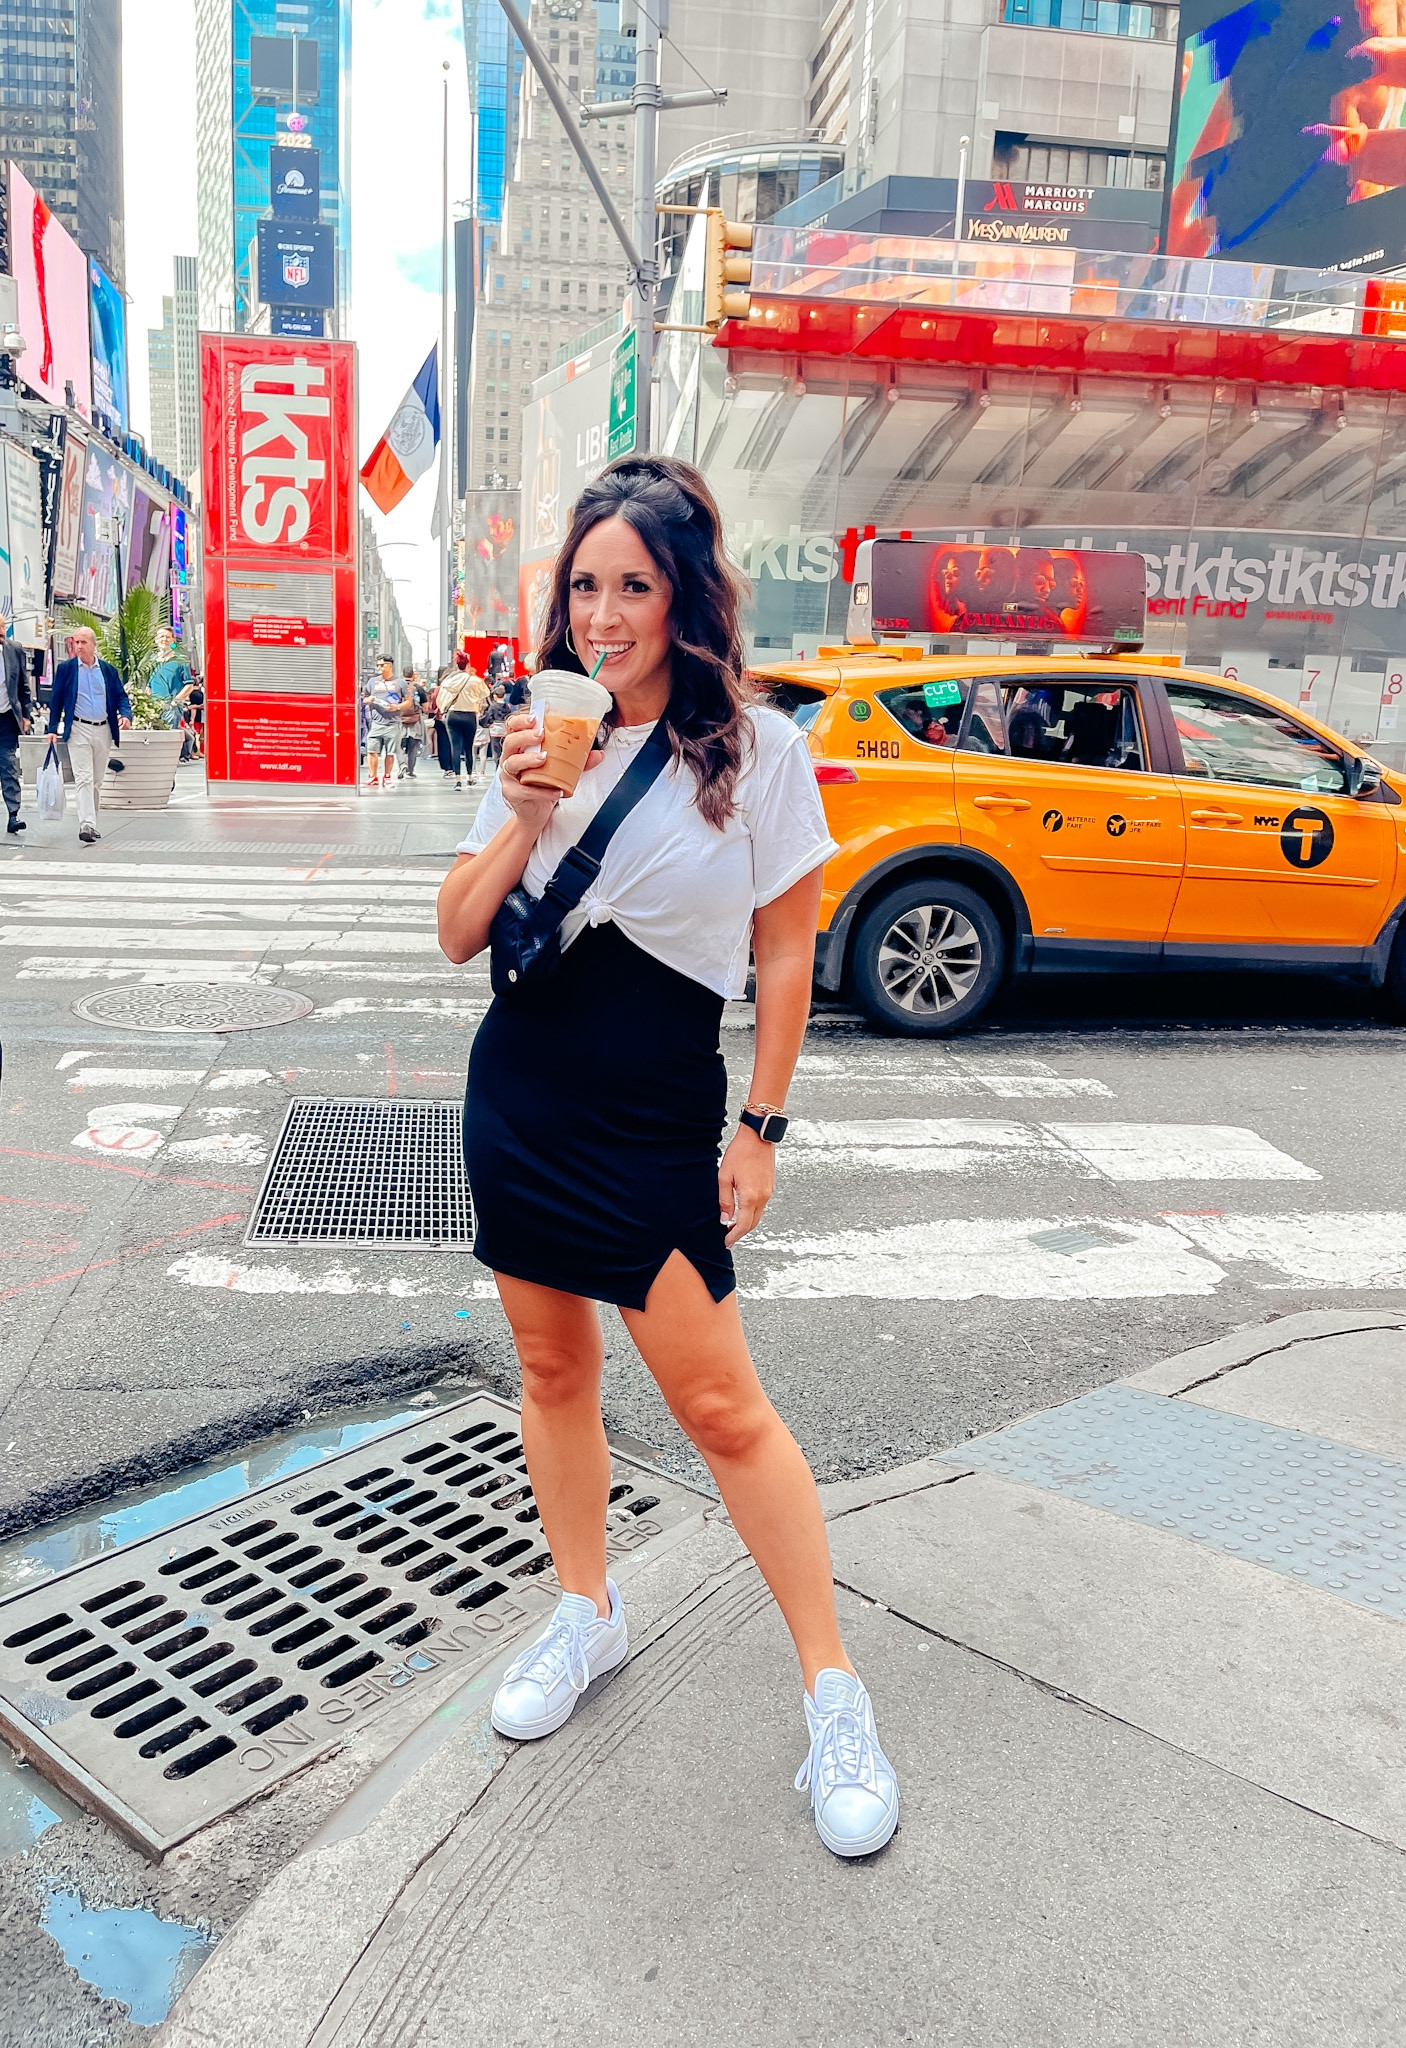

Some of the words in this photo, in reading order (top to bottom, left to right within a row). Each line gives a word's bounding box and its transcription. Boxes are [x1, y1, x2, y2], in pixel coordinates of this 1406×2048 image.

[278, 132, 312, 148] 2022
[1025, 186, 1095, 199] MARRIOTT
[1024, 200, 1085, 212] MARQUIS
[287, 268, 305, 282] NFL
[228, 371, 236, 404] service
[228, 407, 237, 416] of
[228, 419, 237, 454] Theatre
[228, 457, 238, 517] Development
[230, 519, 238, 541] Fund
[1192, 596, 1248, 618] Fund
[960, 612, 1056, 630] ATLANTA
[924, 681, 958, 696] curb
[1307, 670, 1321, 690] 7
[1388, 673, 1404, 694] 8
[857, 740, 900, 758] 5H80
[260, 763, 302, 772] www.tdf.org
[1254, 816, 1280, 826] NYC
[1293, 818, 1324, 860] T
[269, 1482, 316, 1504] MADE
[252, 1500, 273, 1512] IN
[208, 1508, 255, 1530] INDIA
[316, 1600, 528, 1724] FOUNDRIES
[238, 1722, 316, 1772] INC
